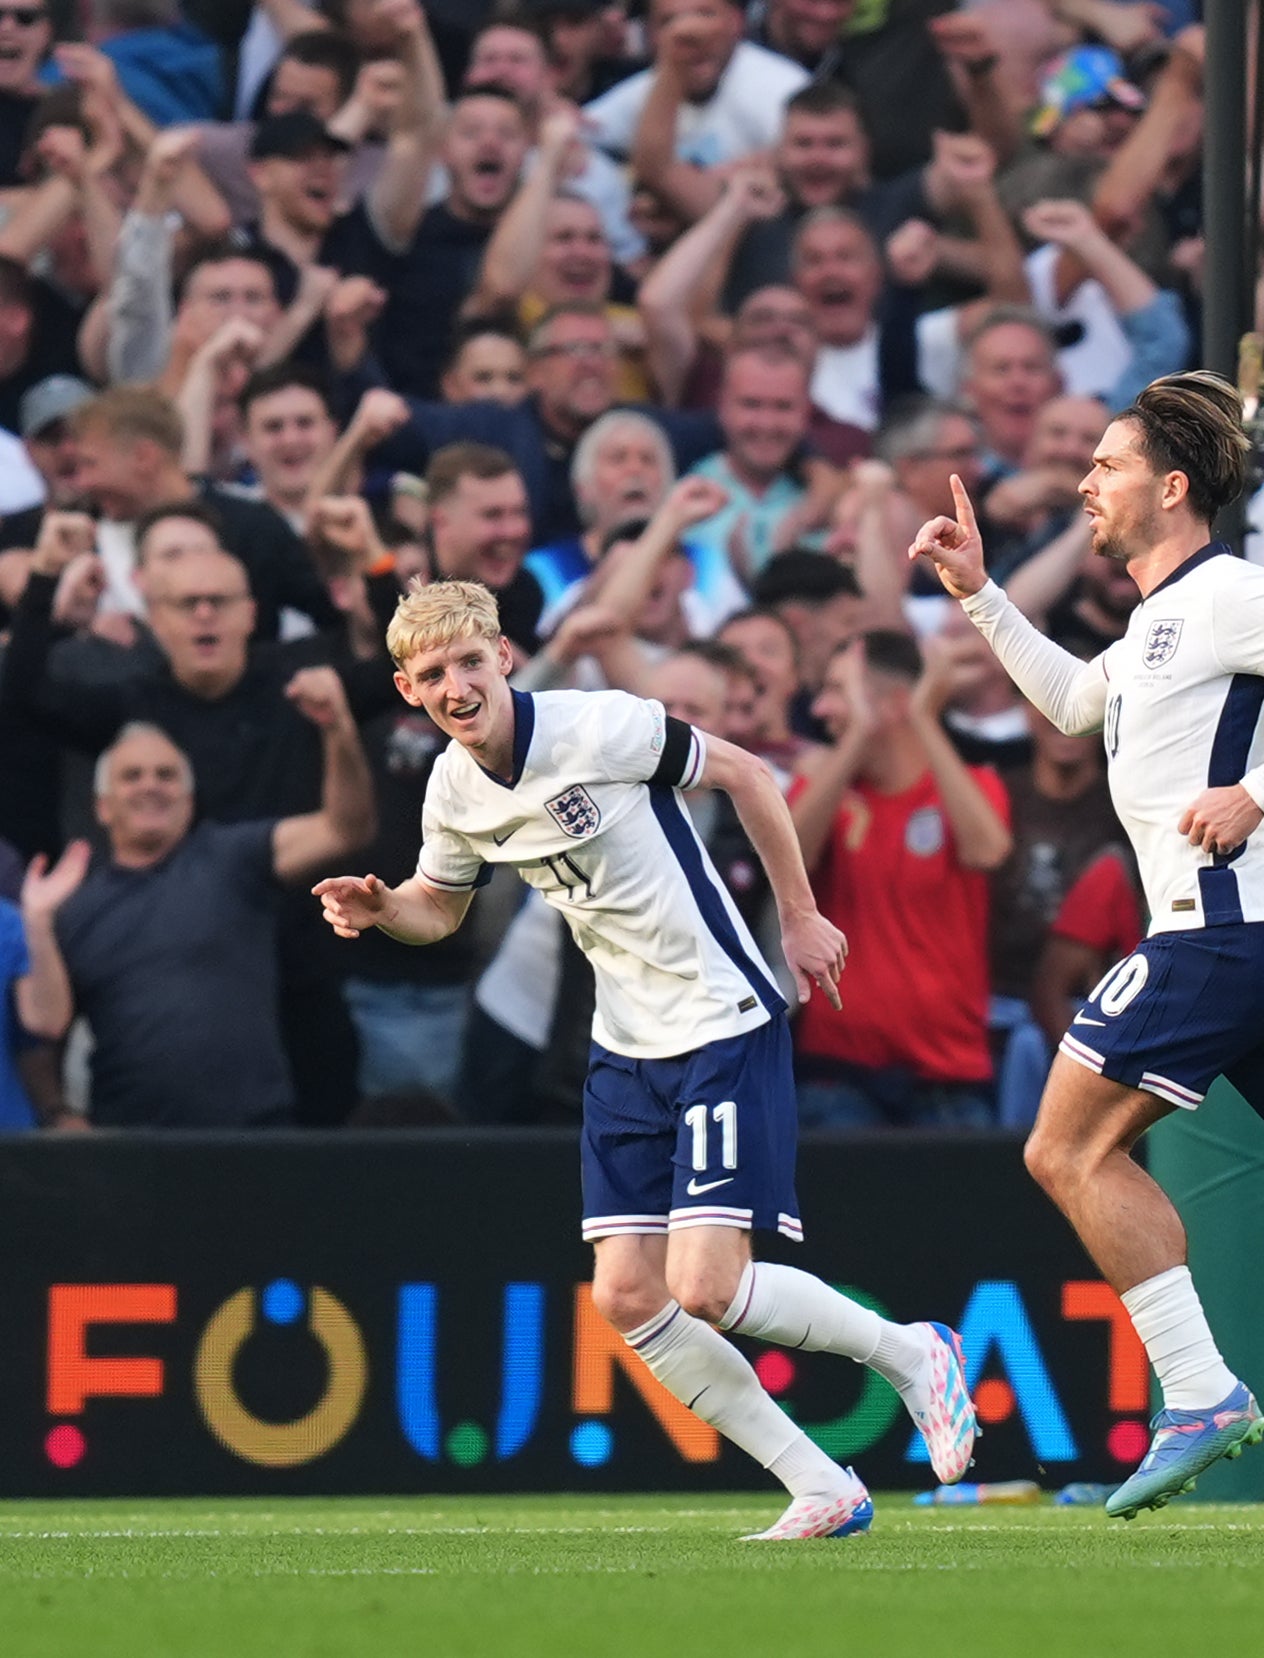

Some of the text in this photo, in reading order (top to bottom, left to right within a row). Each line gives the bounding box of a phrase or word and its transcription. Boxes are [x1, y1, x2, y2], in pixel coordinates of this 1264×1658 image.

[541, 851, 597, 902] 11
[1087, 952, 1149, 1017] 10
[685, 1101, 738, 1171] 11
